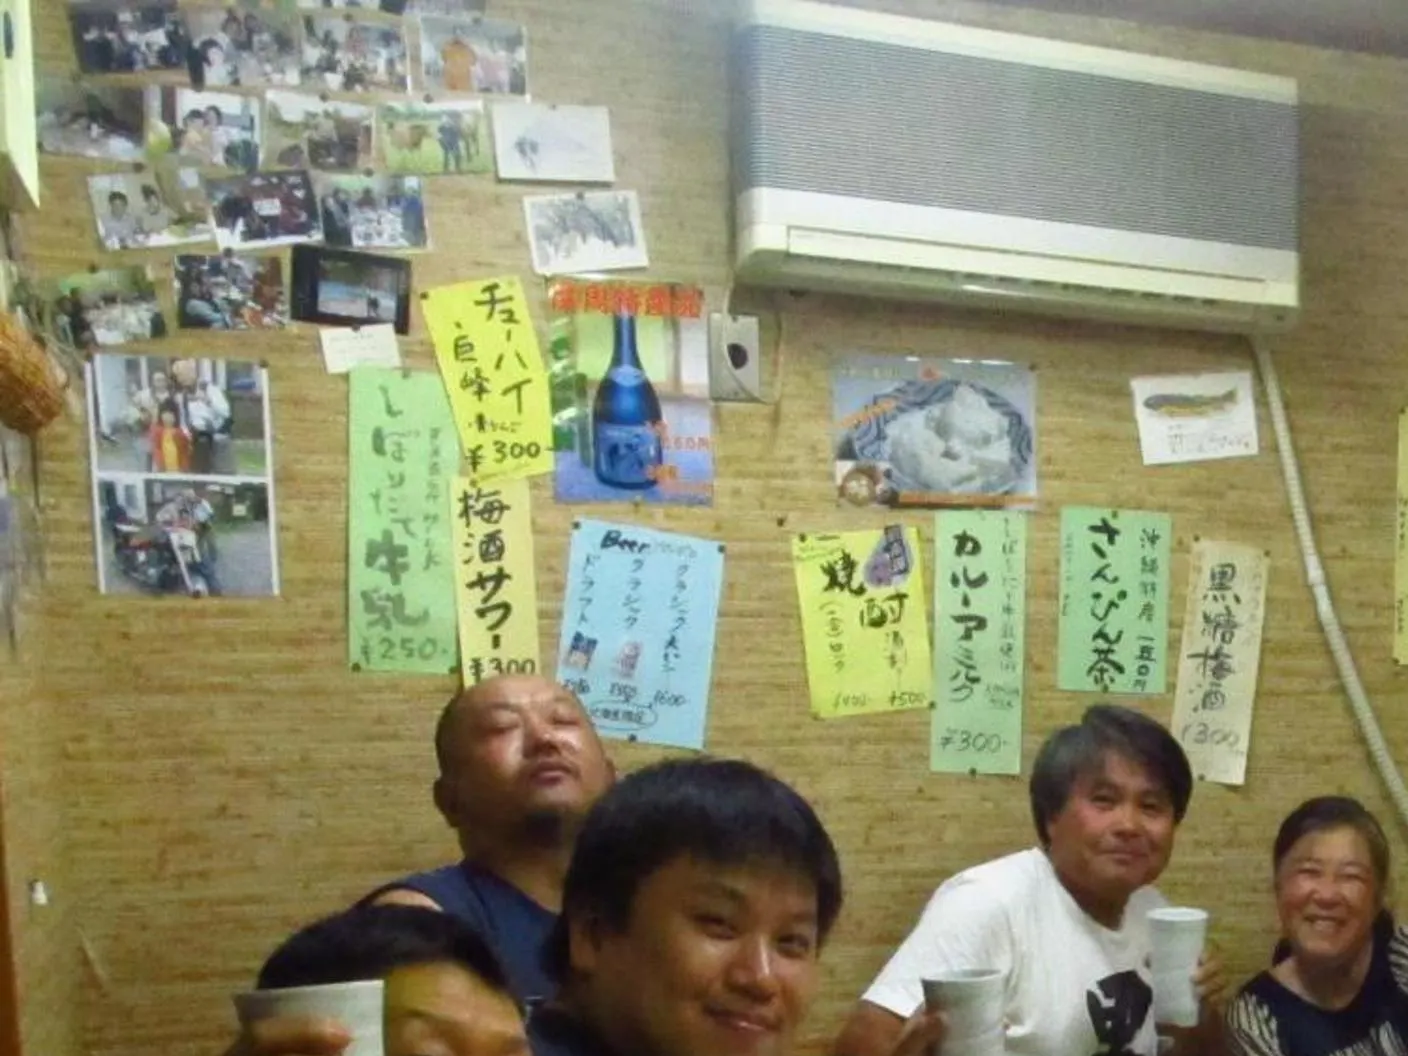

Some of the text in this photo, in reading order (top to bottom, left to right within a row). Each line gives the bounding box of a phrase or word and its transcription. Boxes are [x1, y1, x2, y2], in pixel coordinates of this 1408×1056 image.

[453, 333, 492, 402] 巨峰
[473, 282, 534, 415] チューハイ
[360, 384, 430, 632] しぼりたて牛乳
[465, 440, 541, 473] ¥300
[457, 487, 513, 650] 梅酒サワー
[600, 529, 651, 553] Beer
[819, 549, 910, 629] 焼酎
[1085, 517, 1129, 688] さんぴん茶
[949, 529, 989, 703] カルーアミルク
[1186, 561, 1243, 714] 黒糖梅酒
